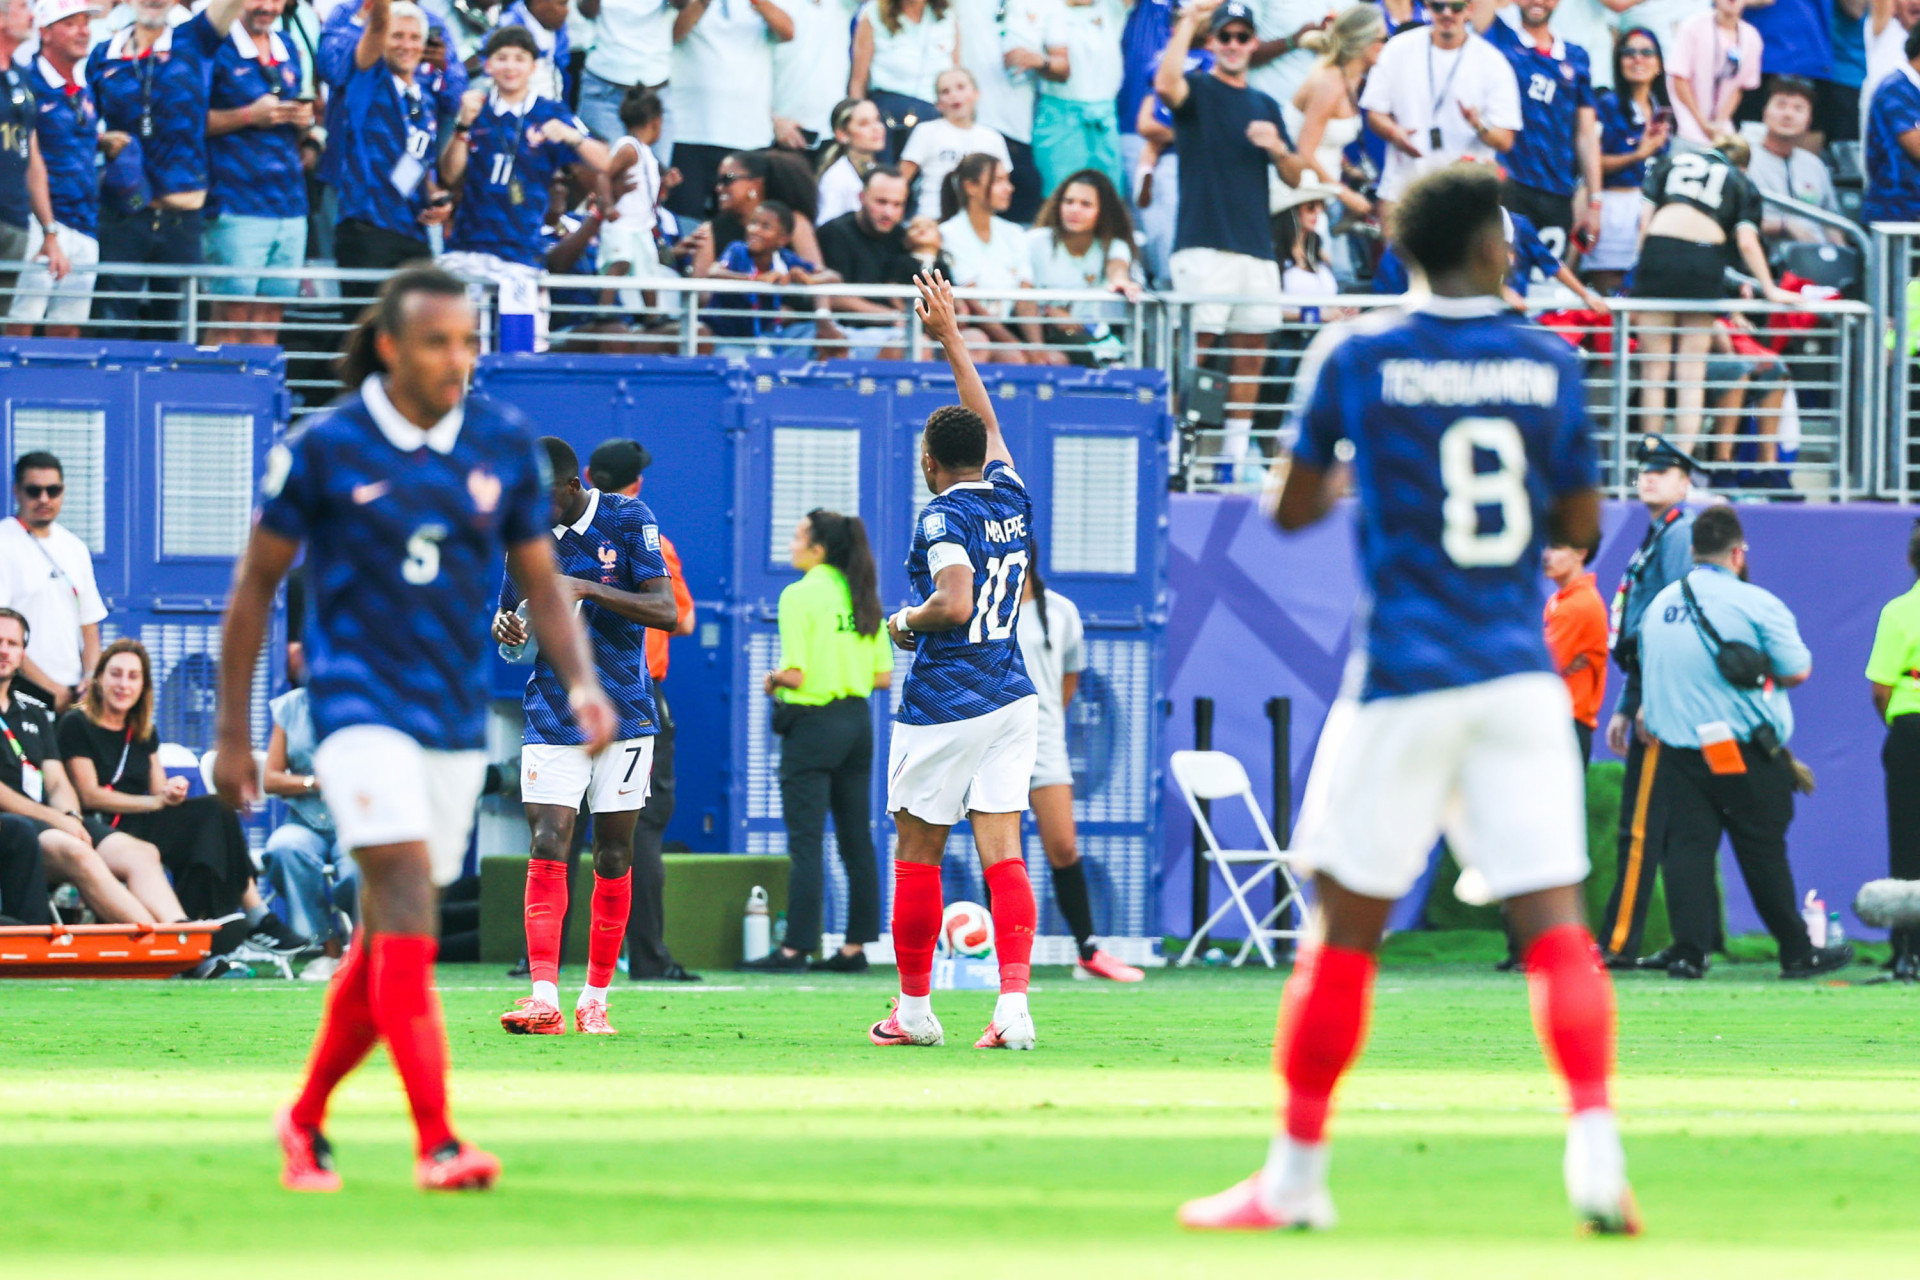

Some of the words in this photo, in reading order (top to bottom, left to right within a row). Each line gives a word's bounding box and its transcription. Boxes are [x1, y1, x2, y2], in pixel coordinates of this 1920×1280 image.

[1528, 73, 1556, 104] 21
[406, 130, 430, 160] 0
[490, 154, 514, 185] 11
[1665, 153, 1728, 209] 21
[1439, 415, 1533, 569] 8
[401, 523, 447, 585] 5
[968, 549, 1029, 643] 10
[623, 746, 642, 783] 7
